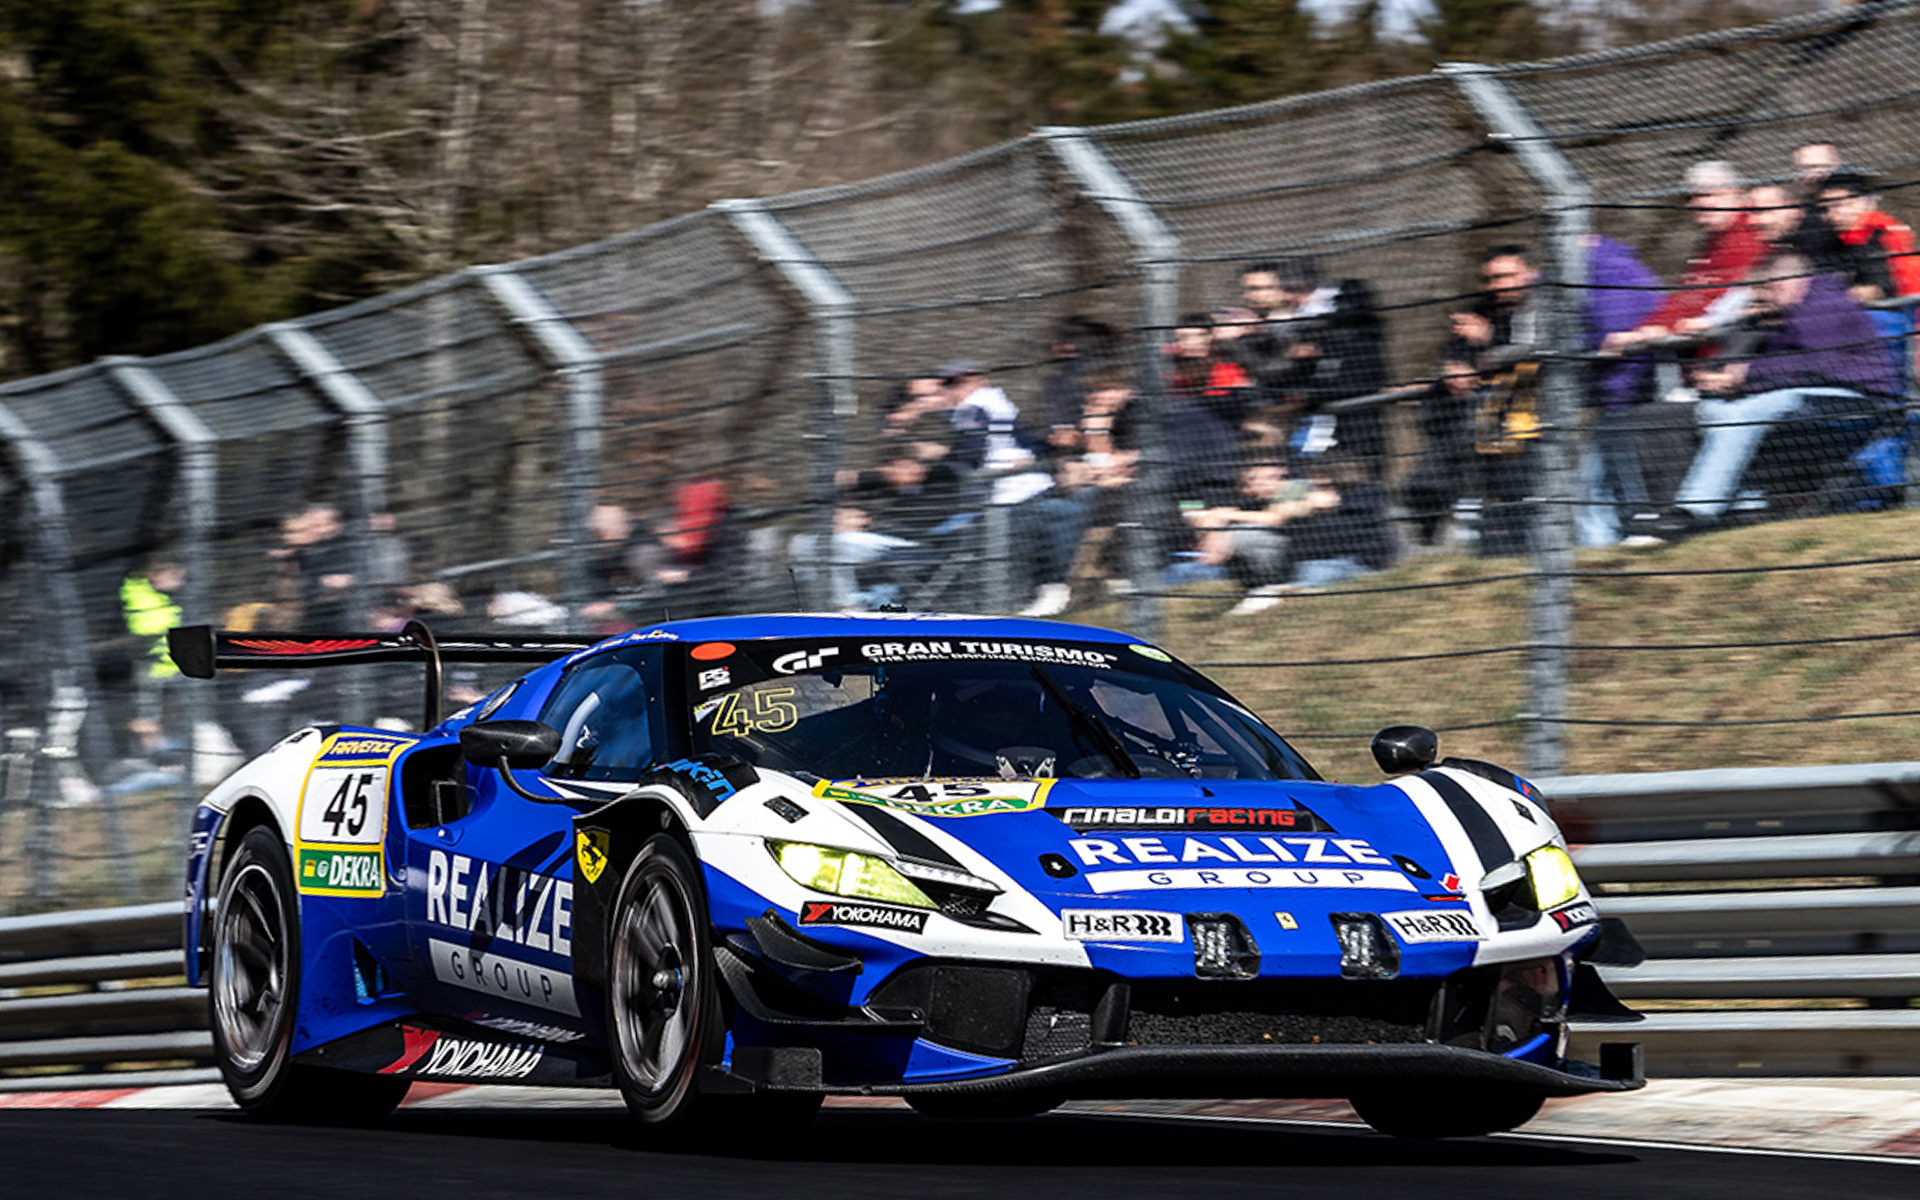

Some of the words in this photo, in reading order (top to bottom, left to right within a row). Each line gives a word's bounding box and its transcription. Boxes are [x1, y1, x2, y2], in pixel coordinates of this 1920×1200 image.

[861, 641, 951, 657] GRAN
[711, 687, 798, 737] 45
[322, 774, 374, 837] 45
[889, 783, 991, 802] 45
[1068, 836, 1394, 867] REALIZE
[328, 854, 380, 888] DEKRA
[1146, 870, 1366, 886] GROUP
[427, 850, 574, 958] REALIZE
[831, 905, 921, 929] YOKOHAMA
[1068, 914, 1132, 932] H&R
[1392, 914, 1451, 935] H&R
[451, 951, 553, 1003] GROUP
[416, 1037, 545, 1078] YOKOHAMA
